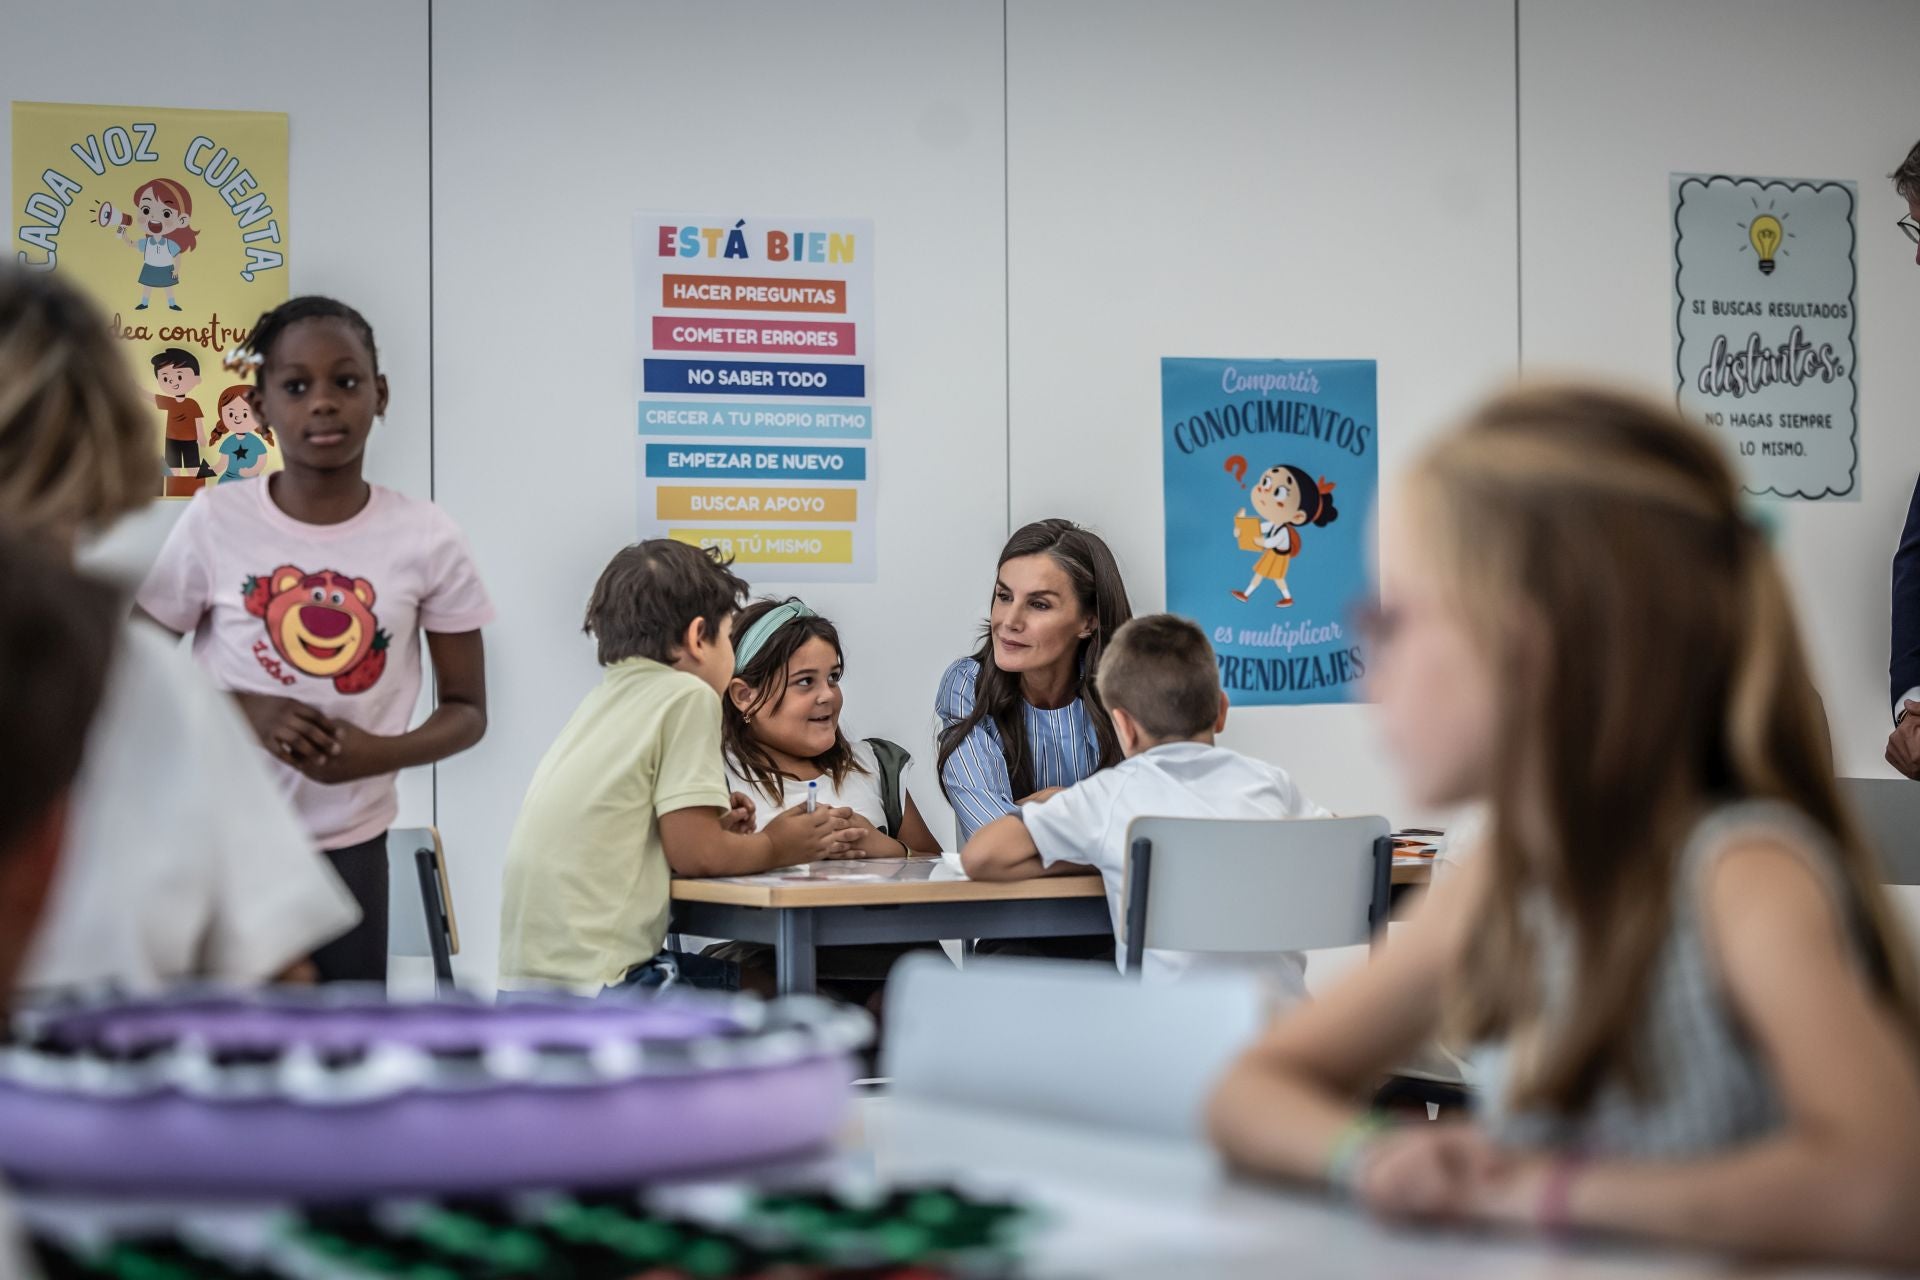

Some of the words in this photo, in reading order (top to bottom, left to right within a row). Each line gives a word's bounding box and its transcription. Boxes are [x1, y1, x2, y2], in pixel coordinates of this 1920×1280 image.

[18, 168, 82, 273] CADA
[71, 123, 159, 175] VOZ
[183, 135, 284, 282] CUENTA,
[658, 219, 749, 259] ESTÁ
[766, 230, 854, 264] BIEN
[673, 284, 731, 300] HACER
[735, 286, 836, 305] PREGUNTAS
[1692, 300, 1706, 314] SI
[1712, 301, 1762, 316] BUSCAS
[1768, 302, 1847, 318] RESULTADOS
[110, 312, 153, 342] dea
[158, 312, 248, 353] constru
[672, 326, 757, 344] COMETER
[762, 329, 838, 347] ERRORES
[1698, 325, 1844, 398] distintos.
[688, 369, 712, 385] NO
[718, 371, 774, 386] SABER
[777, 372, 827, 388] TODO
[1222, 367, 1321, 396] Compartir
[646, 410, 708, 425] CRECER
[712, 411, 724, 426] A
[729, 412, 750, 427] TU
[754, 412, 811, 427] PROPIO
[815, 413, 865, 428] RITMO
[1173, 400, 1371, 456] CONOCIMIENTOS
[1705, 413, 1723, 426] NO
[1730, 413, 1773, 428] HAGAS
[1779, 413, 1832, 429] SIEMPRE
[1740, 441, 1755, 456] LO
[1761, 442, 1807, 457] MISMO.
[668, 453, 752, 468] EMPEZAR
[756, 454, 778, 469] DE
[782, 454, 844, 470] NUEVO
[691, 496, 759, 511] BUSCAR
[764, 497, 824, 512] APOYO
[700, 538, 732, 552] SER
[737, 534, 762, 553] TÚ
[766, 539, 822, 554] MISMO
[1214, 626, 1234, 643] es
[1239, 620, 1343, 652] multiplicar
[1216, 646, 1366, 691] RENDIZAJES
